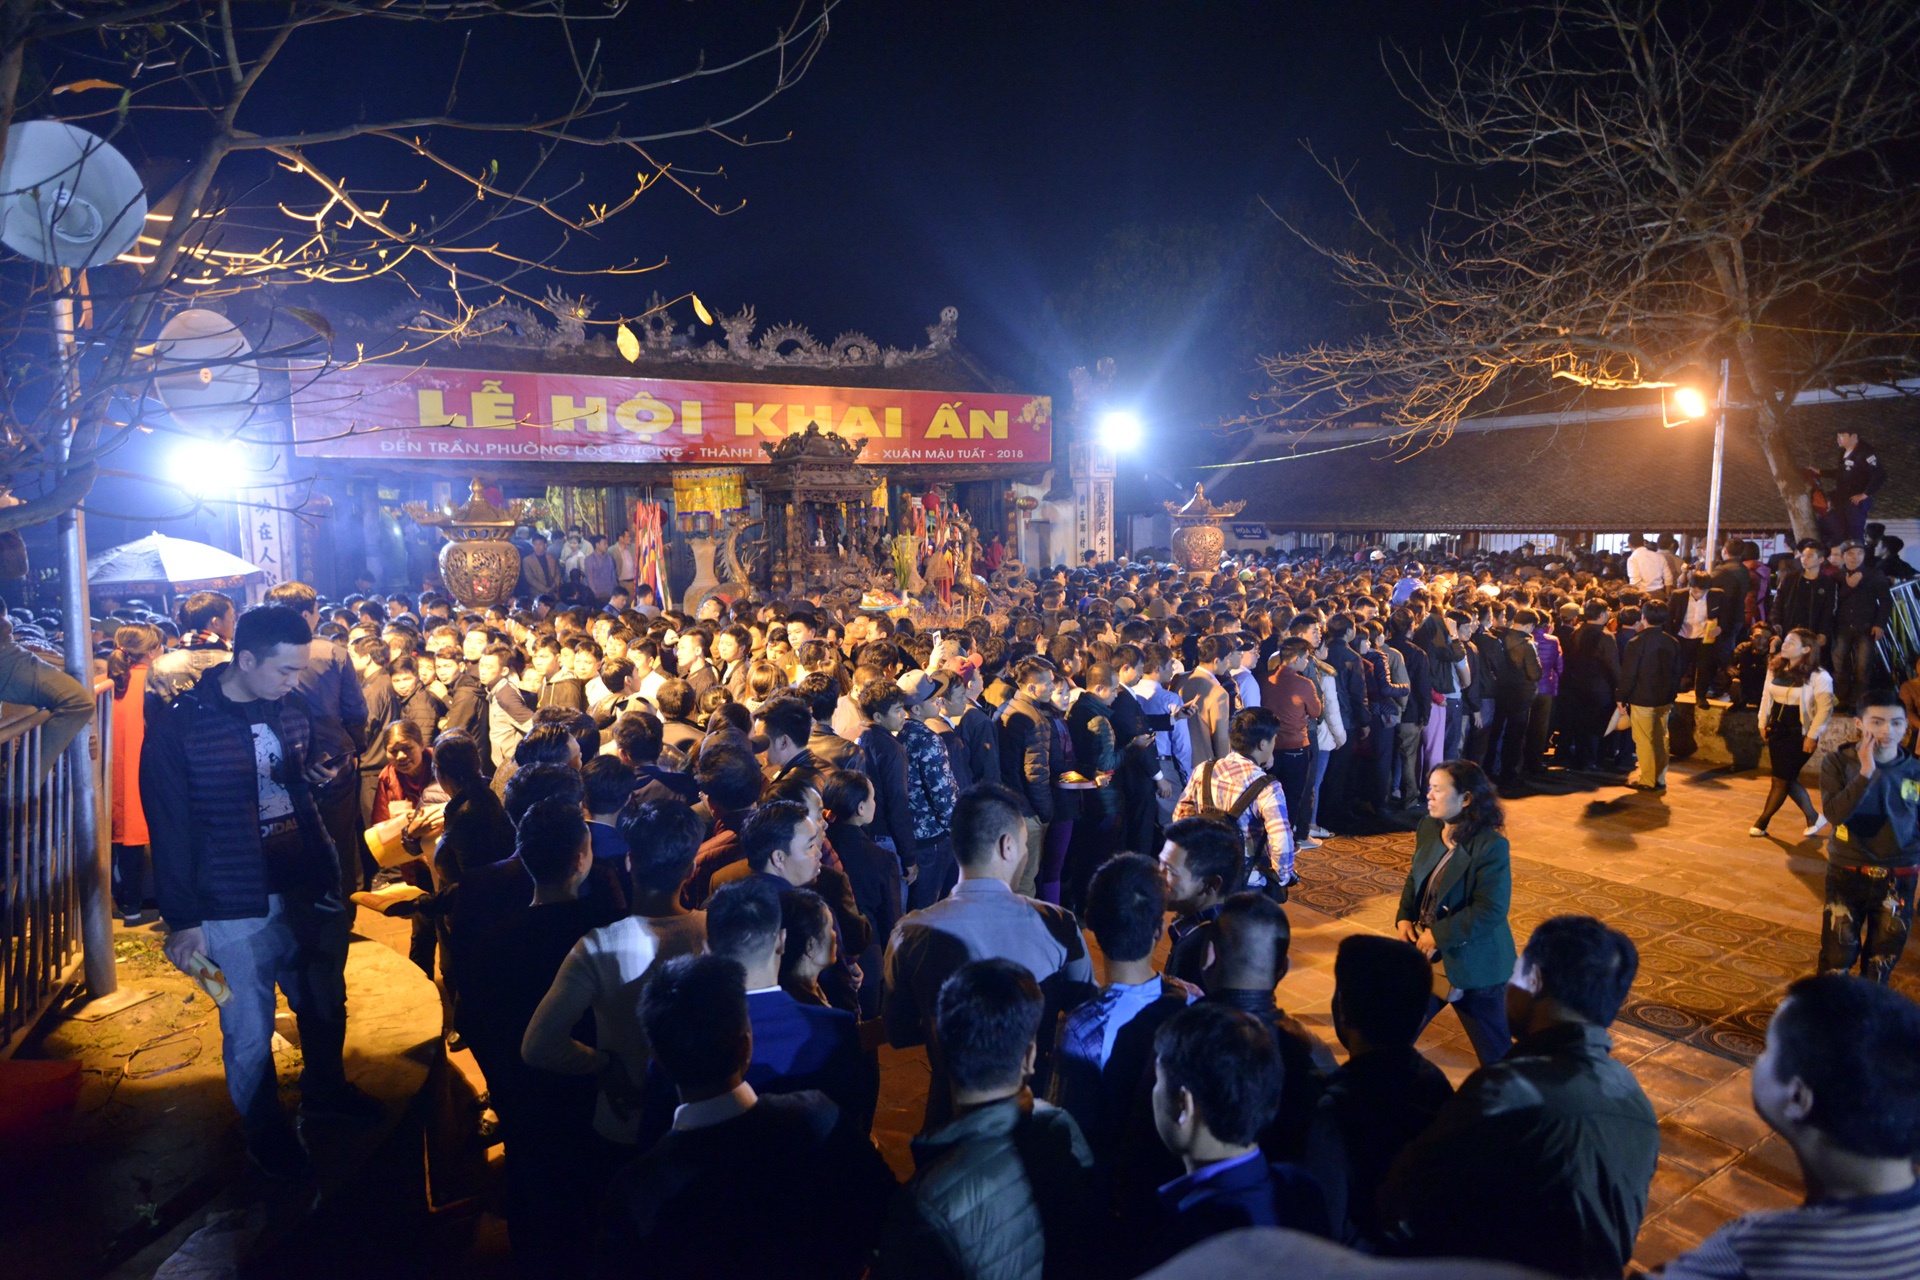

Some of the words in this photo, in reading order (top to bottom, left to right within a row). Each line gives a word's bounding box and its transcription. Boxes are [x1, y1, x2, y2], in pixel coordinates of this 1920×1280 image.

[418, 380, 516, 430] LỄ
[551, 391, 703, 442] HỘI
[735, 402, 902, 438] KHAI
[924, 401, 1009, 439] ẤN
[380, 438, 422, 452] ĐỀN
[575, 443, 612, 457] LỘC
[620, 446, 684, 458] VƯỢNG
[700, 445, 753, 458] THÀNH
[883, 448, 921, 459] XUÂN
[925, 448, 954, 460] MẬU
[958, 447, 985, 459] TUẤT
[997, 449, 1024, 459] 2018
